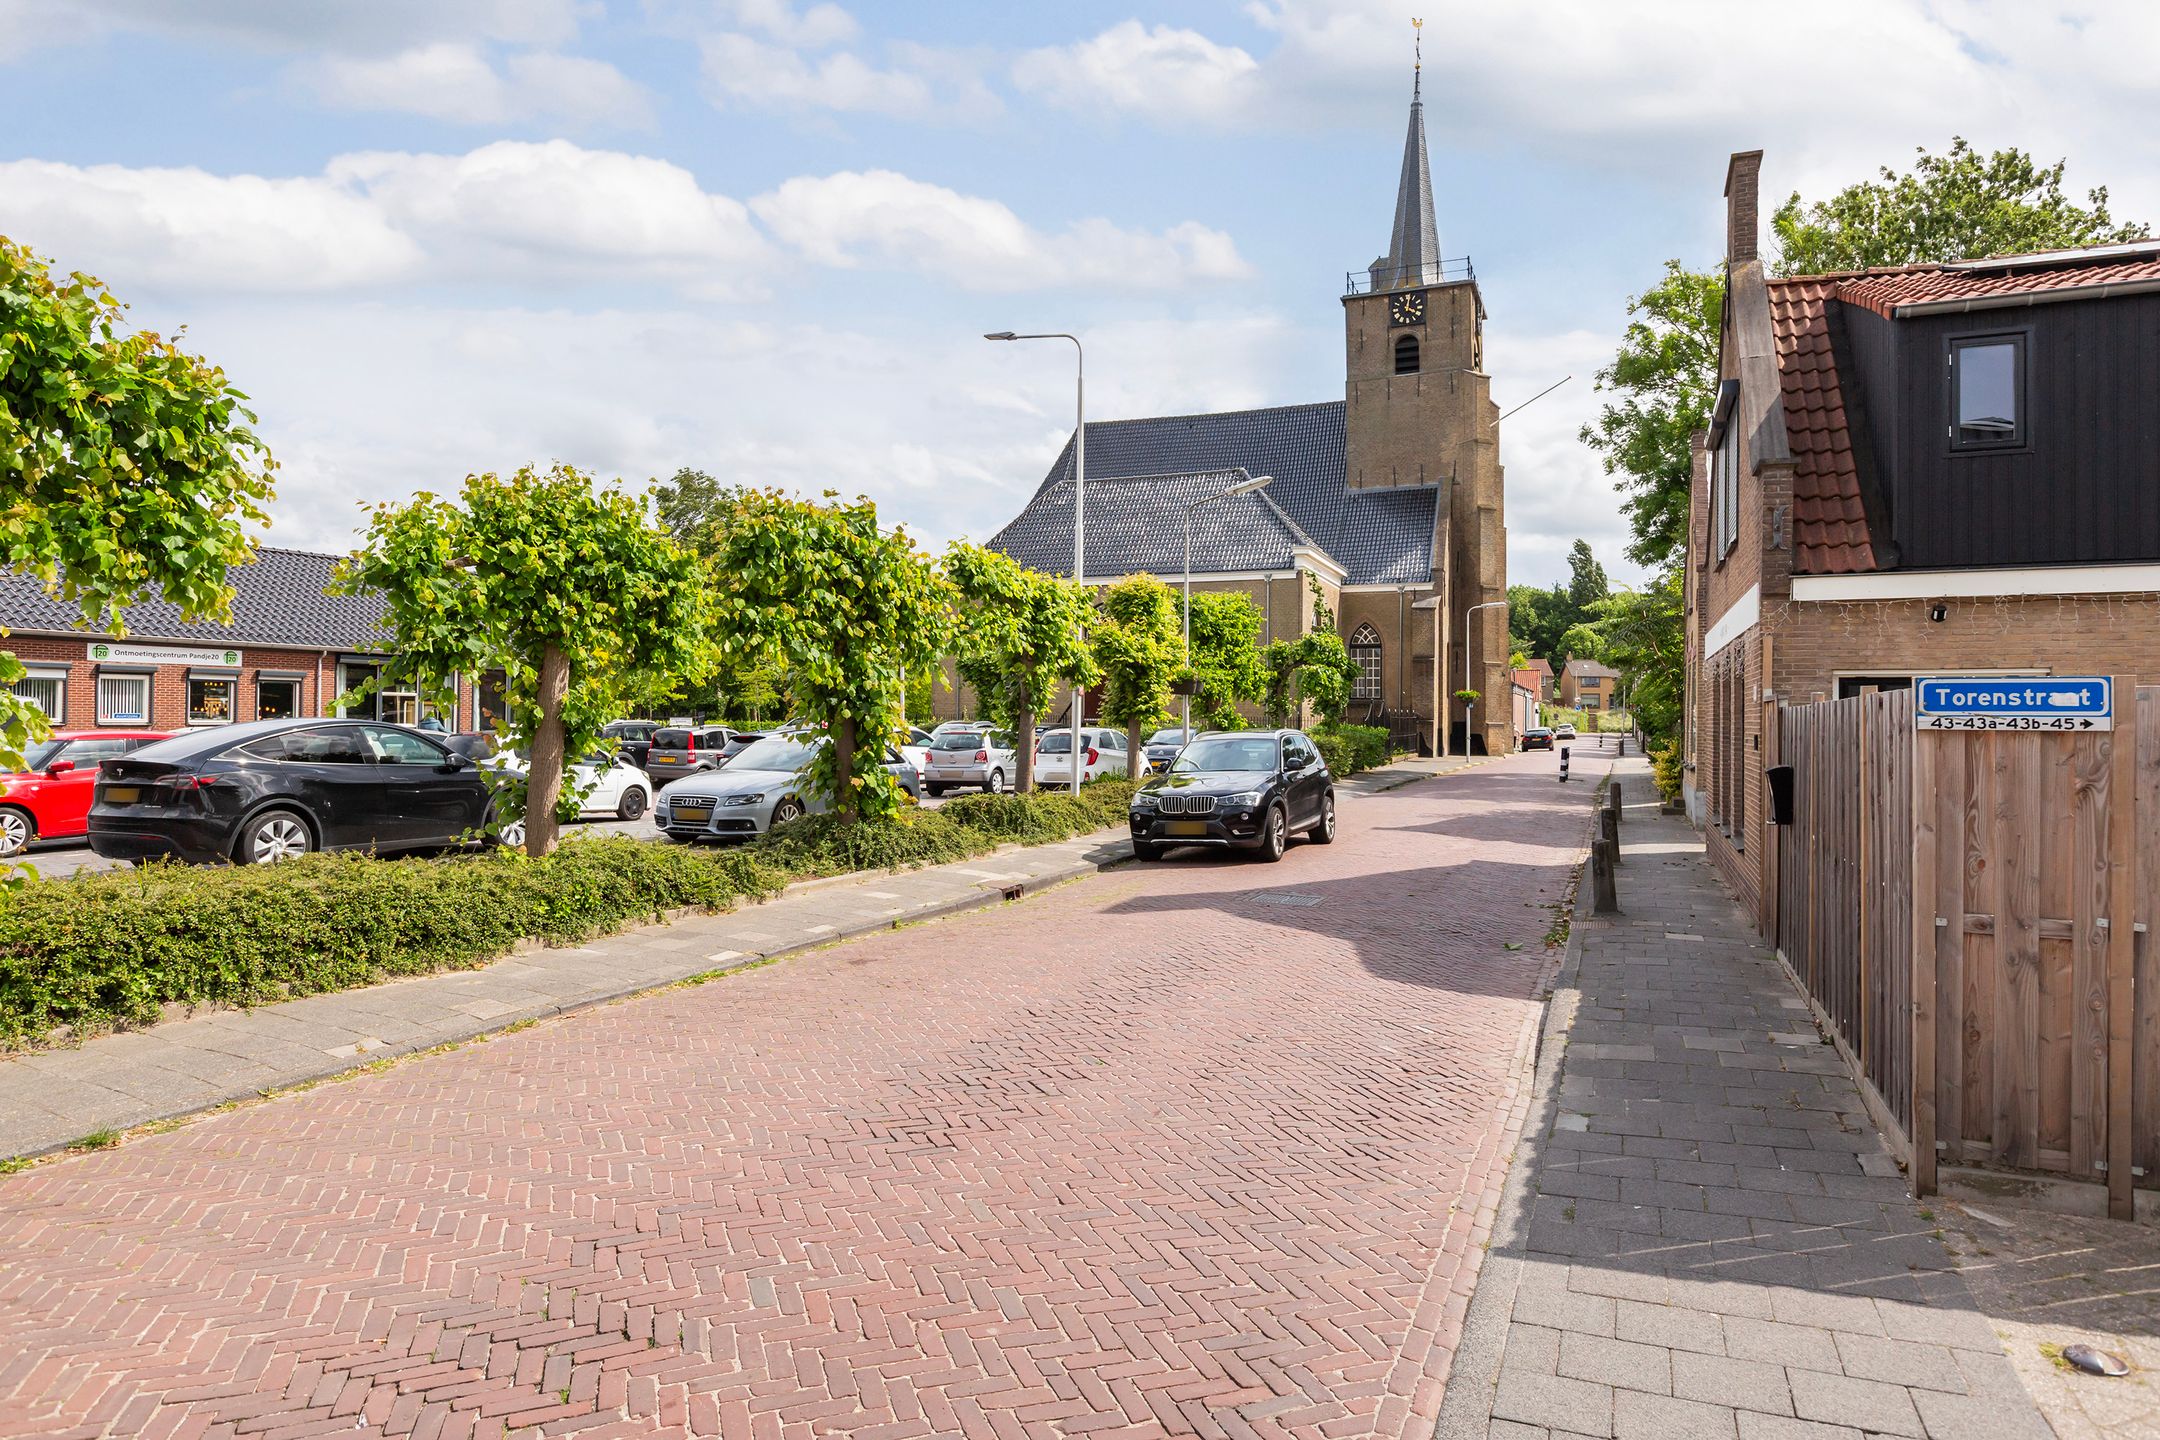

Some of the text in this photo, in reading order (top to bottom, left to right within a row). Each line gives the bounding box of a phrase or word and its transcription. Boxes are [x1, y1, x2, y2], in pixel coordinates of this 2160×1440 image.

[114, 649, 219, 661] Ontmoetingscentrum Pandje20
[1935, 688, 2091, 706] Torenstrt
[1930, 717, 2075, 730] 43-43a-43b-45
